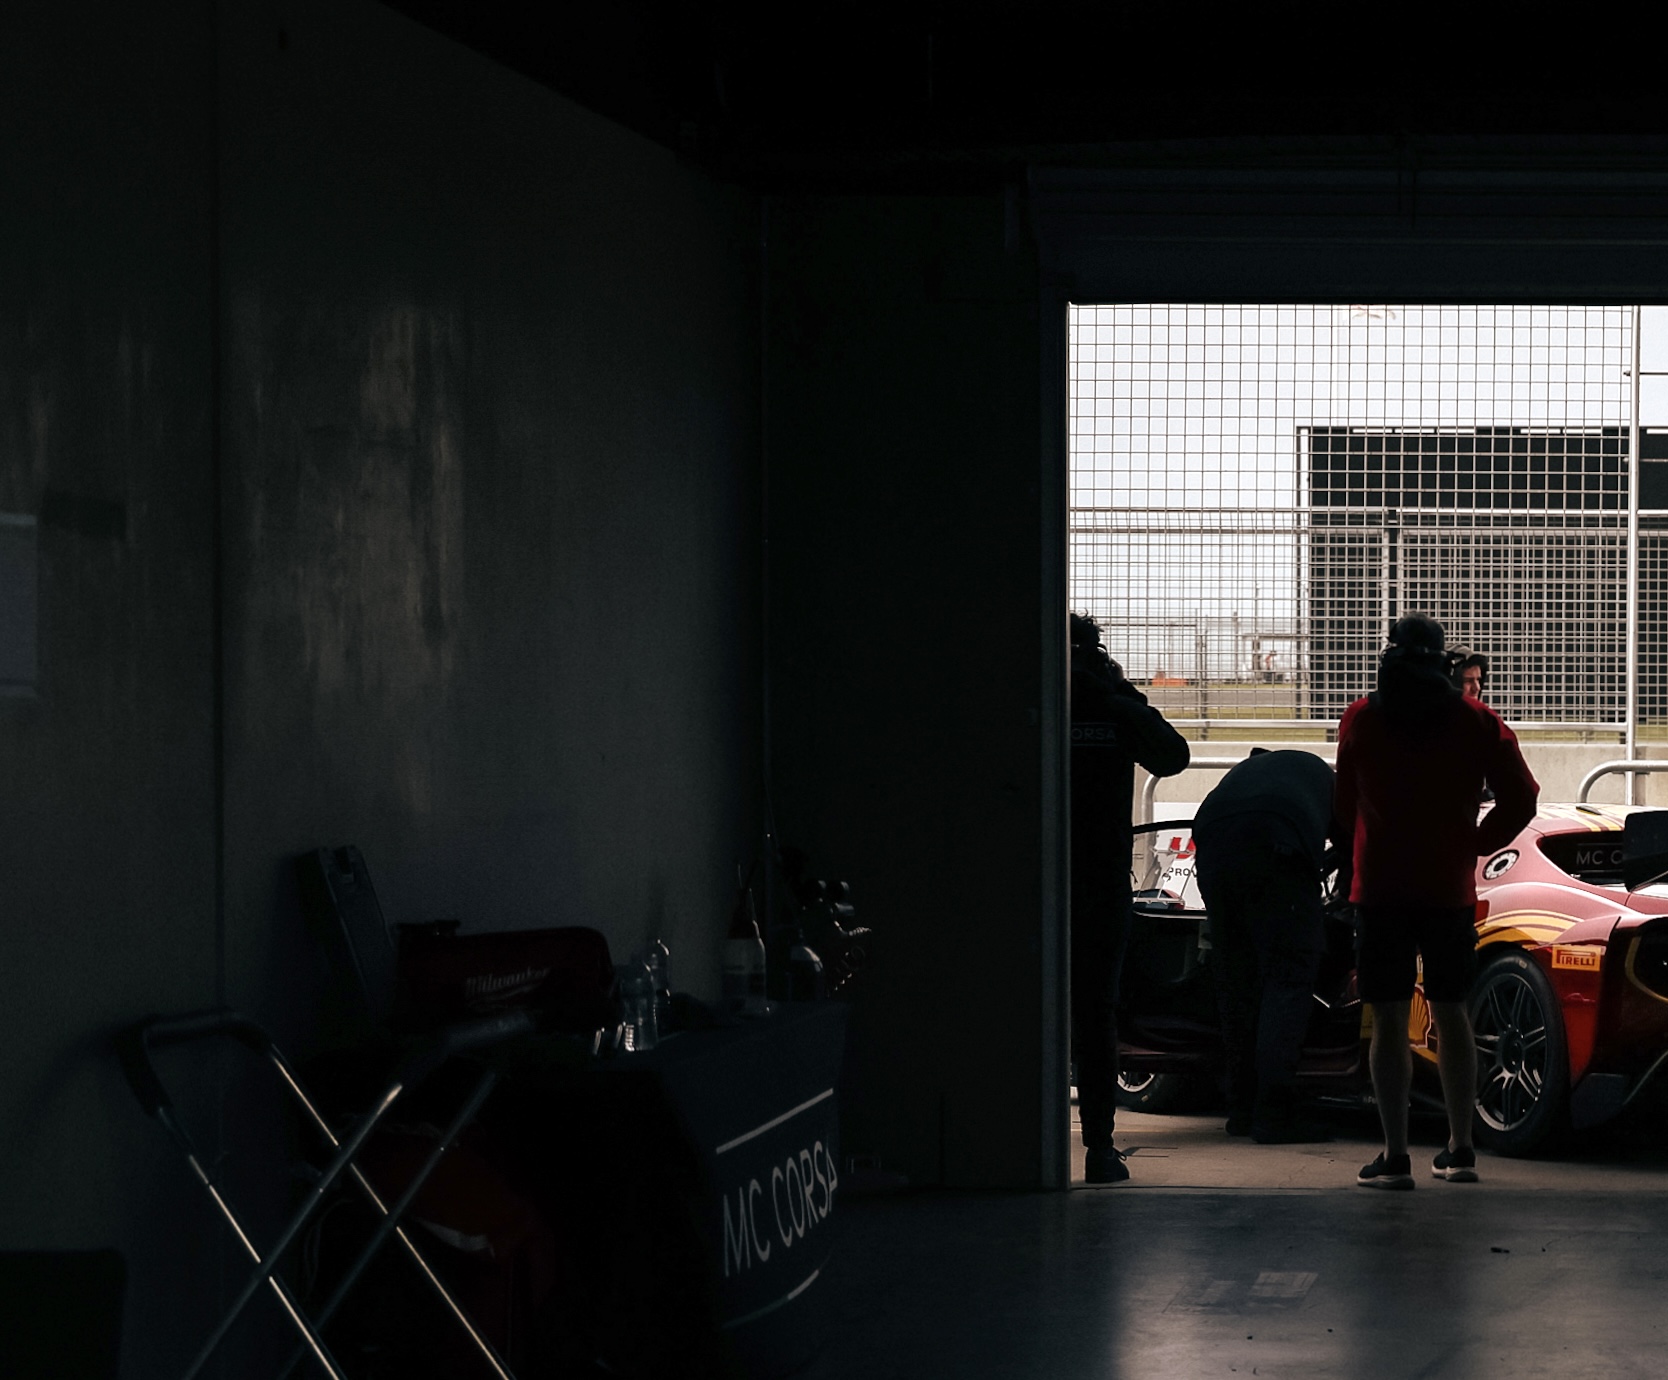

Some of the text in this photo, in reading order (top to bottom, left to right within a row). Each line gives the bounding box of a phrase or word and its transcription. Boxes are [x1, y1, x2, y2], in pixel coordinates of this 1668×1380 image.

[1071, 727, 1117, 741] ORSA
[1576, 850, 1604, 865] MC
[1556, 950, 1596, 966] PIRELLI
[723, 1138, 839, 1277] MC CORSA
